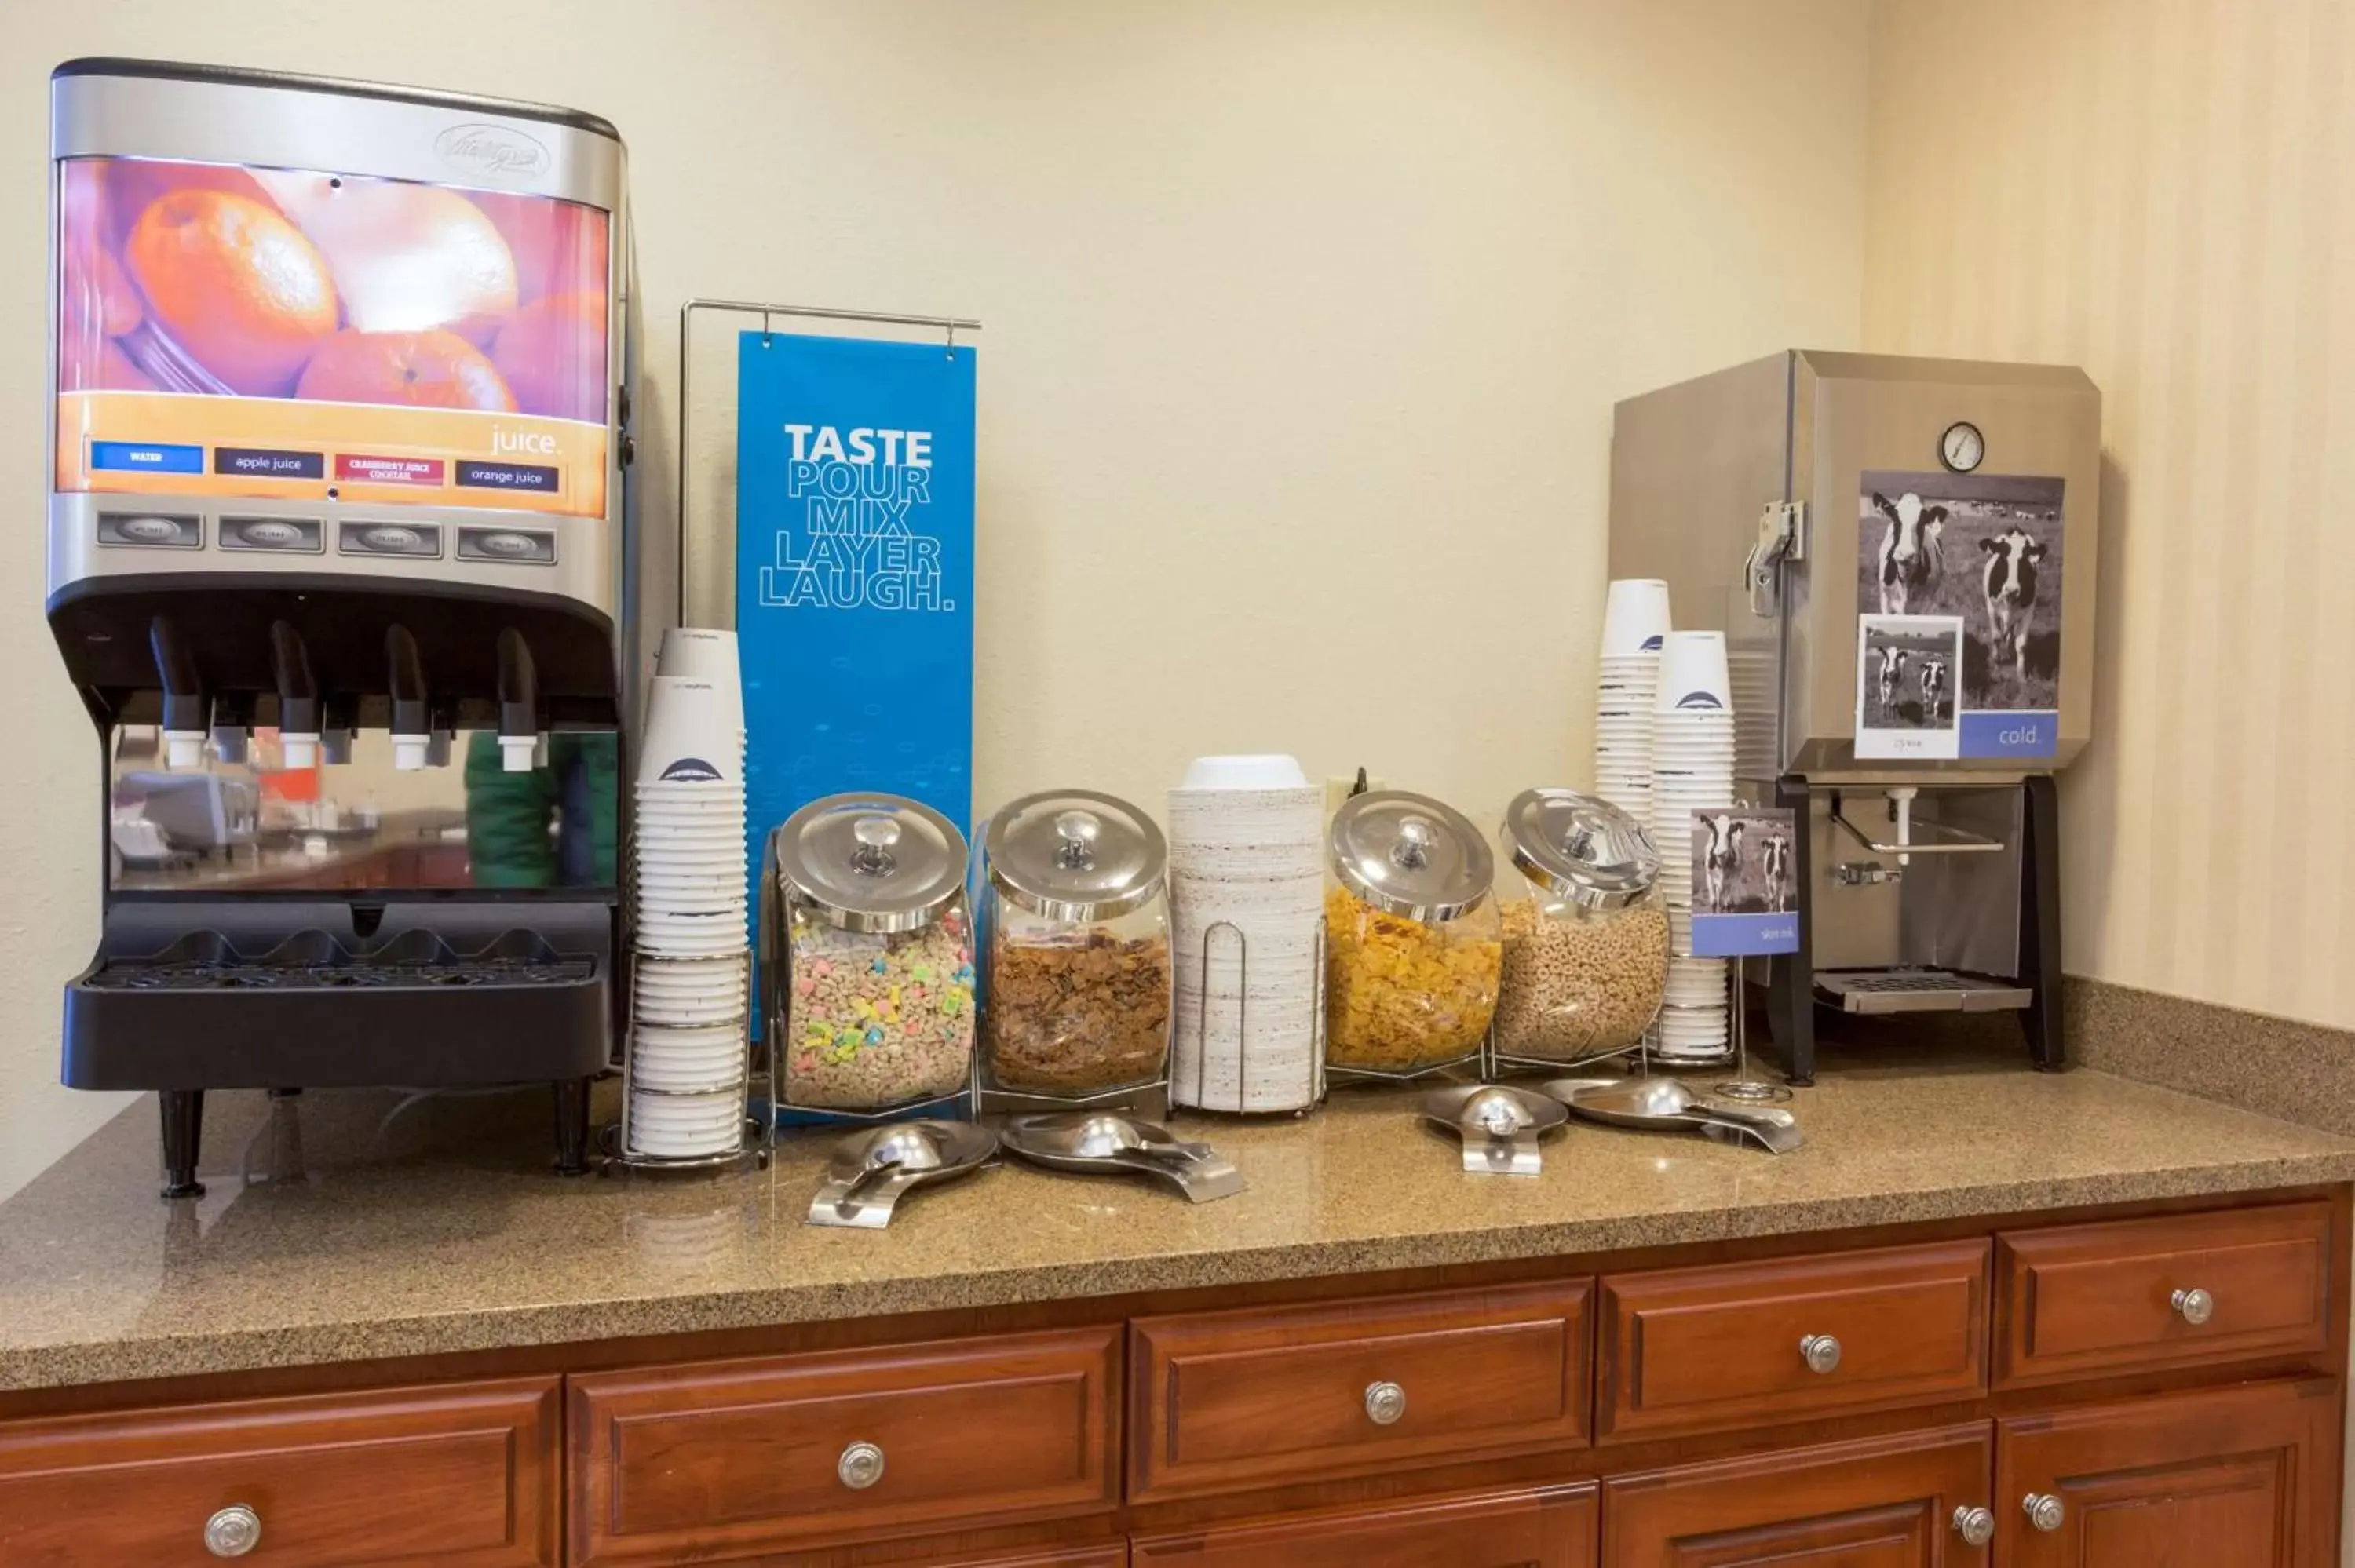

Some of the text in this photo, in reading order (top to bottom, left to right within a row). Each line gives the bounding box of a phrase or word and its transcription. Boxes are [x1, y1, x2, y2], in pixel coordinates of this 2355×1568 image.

[129, 451, 163, 463] WATER
[490, 424, 563, 456] juice.
[784, 424, 933, 469] TASTE
[236, 456, 302, 471] apple juice
[471, 468, 542, 484] orange juice
[788, 458, 931, 503] POUR
[807, 495, 913, 538] MIX
[776, 531, 942, 575] LAYER
[759, 567, 955, 612] LAUGH.
[1999, 724, 2042, 745] cold.
